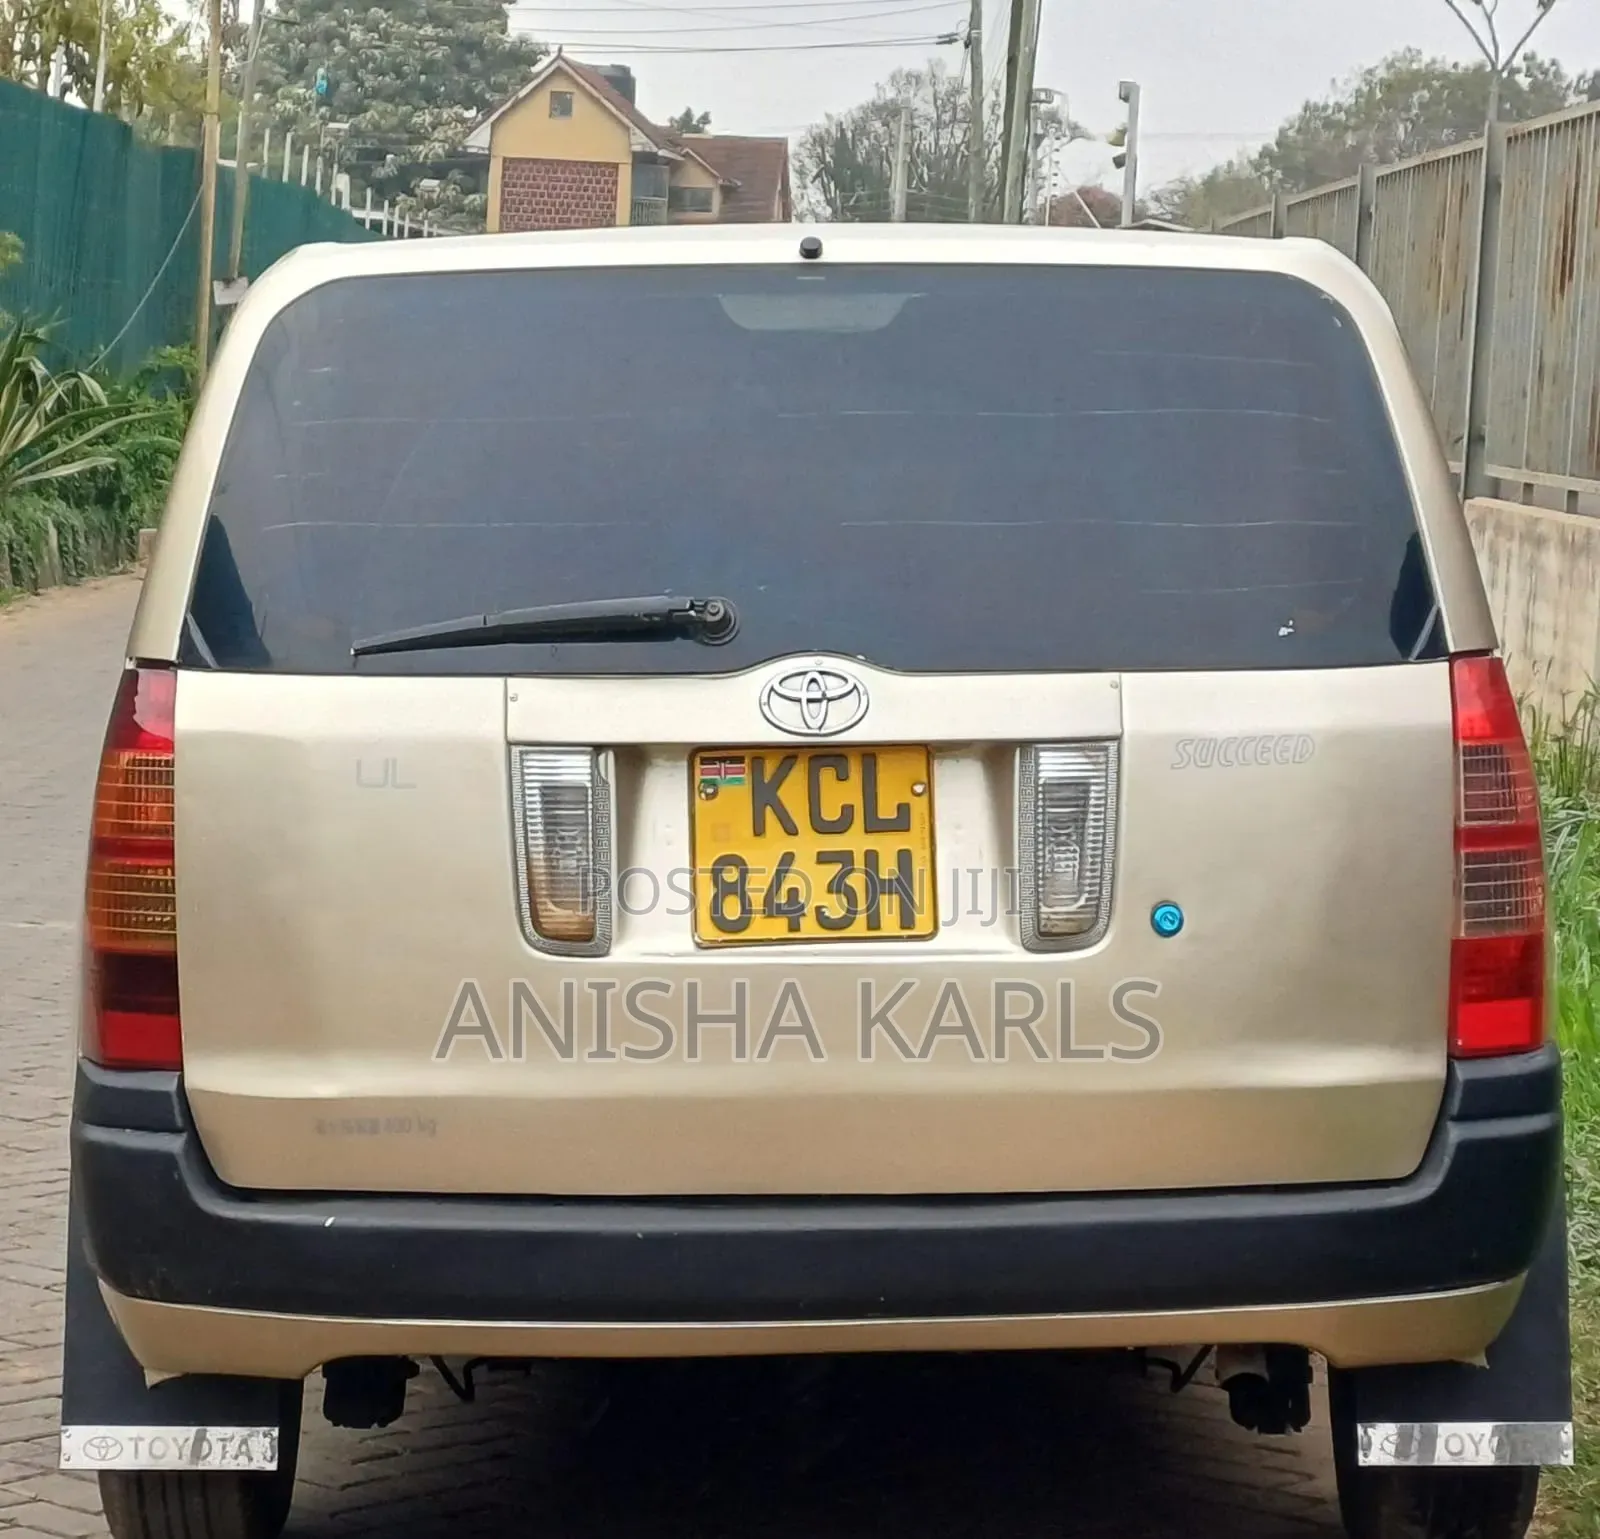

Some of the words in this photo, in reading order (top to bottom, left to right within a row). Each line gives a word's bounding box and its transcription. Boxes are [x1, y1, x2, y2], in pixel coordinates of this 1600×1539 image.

[1170, 733, 1315, 770] SUCCEED
[751, 753, 911, 836] KCL
[709, 848, 915, 933] 843H
[127, 1434, 253, 1464] TOYOTA
